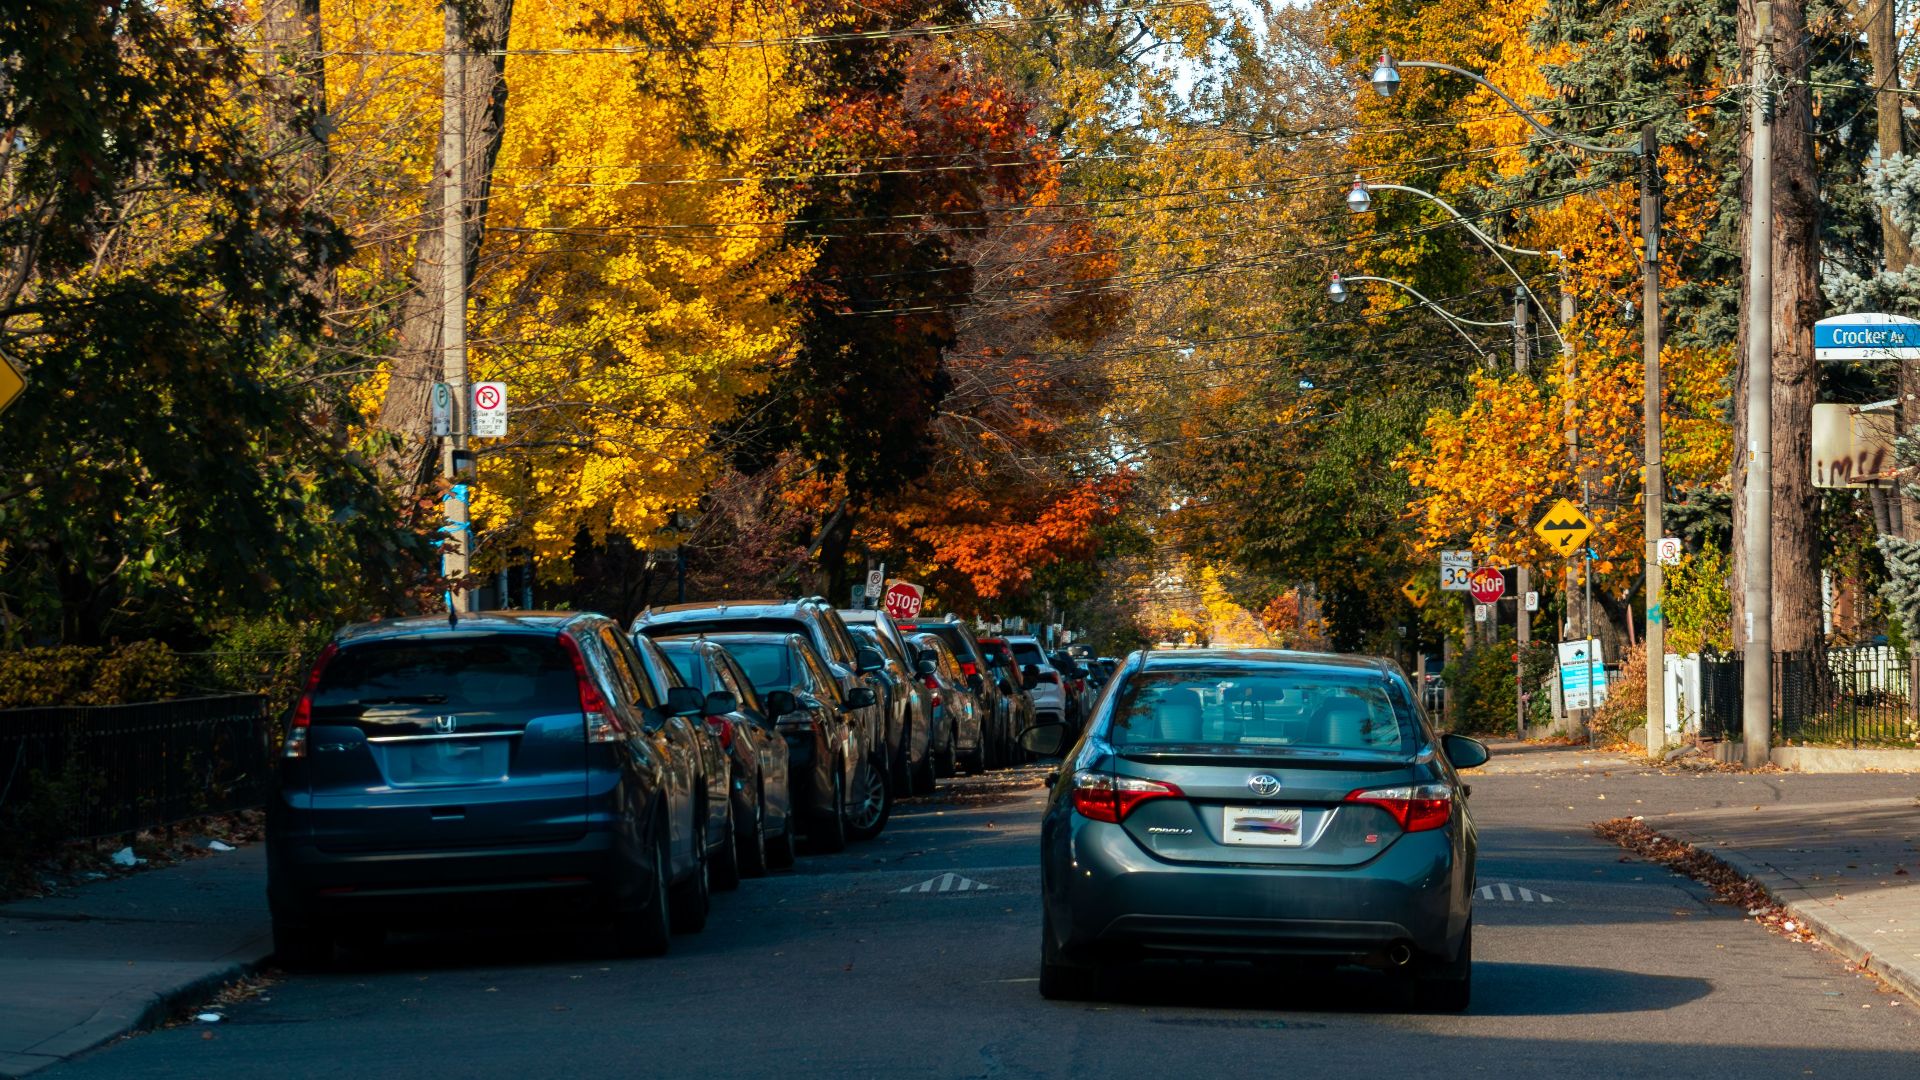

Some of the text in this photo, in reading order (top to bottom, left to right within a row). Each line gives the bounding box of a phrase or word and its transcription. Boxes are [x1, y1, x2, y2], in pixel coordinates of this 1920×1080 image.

[1832, 328, 1887, 345] Crocker
[1445, 567, 1469, 585] 30
[1472, 577, 1503, 594] STOP
[887, 591, 920, 611] STOP
